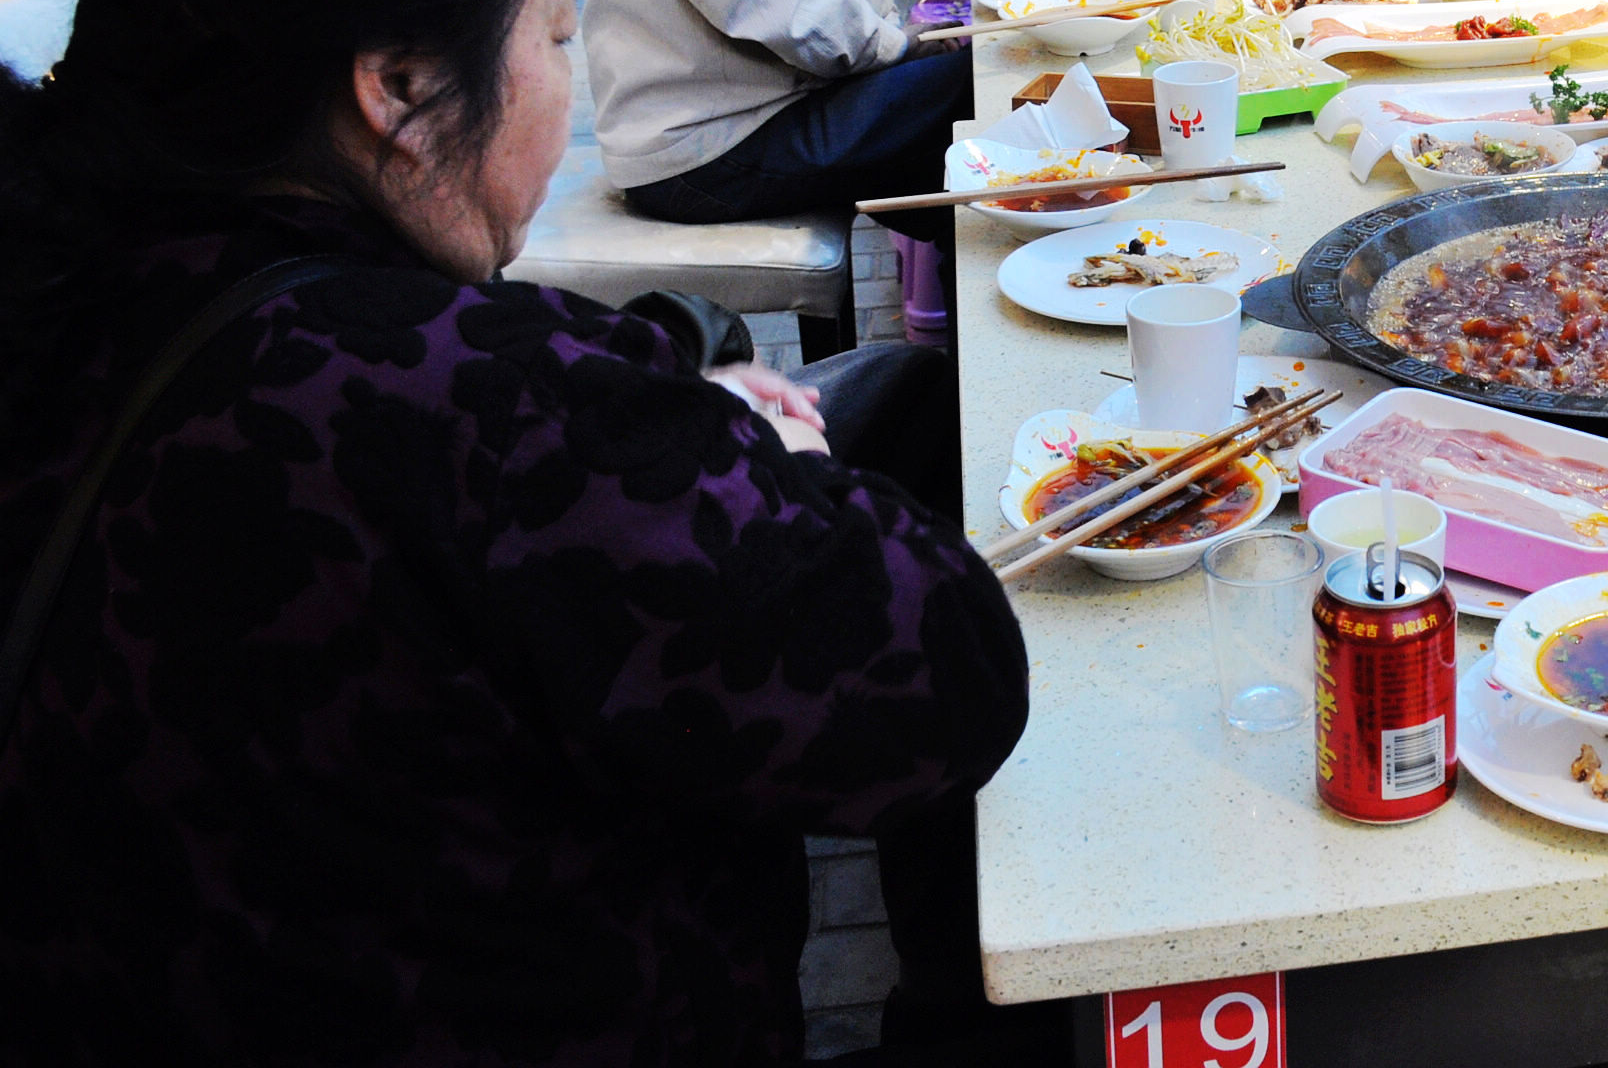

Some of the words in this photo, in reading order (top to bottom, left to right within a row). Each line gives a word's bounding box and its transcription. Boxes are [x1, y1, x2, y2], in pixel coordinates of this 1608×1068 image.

[1341, 619, 1379, 638] 王老吉
[1391, 614, 1438, 638] 独家秘方
[1122, 991, 1269, 1068] 19
